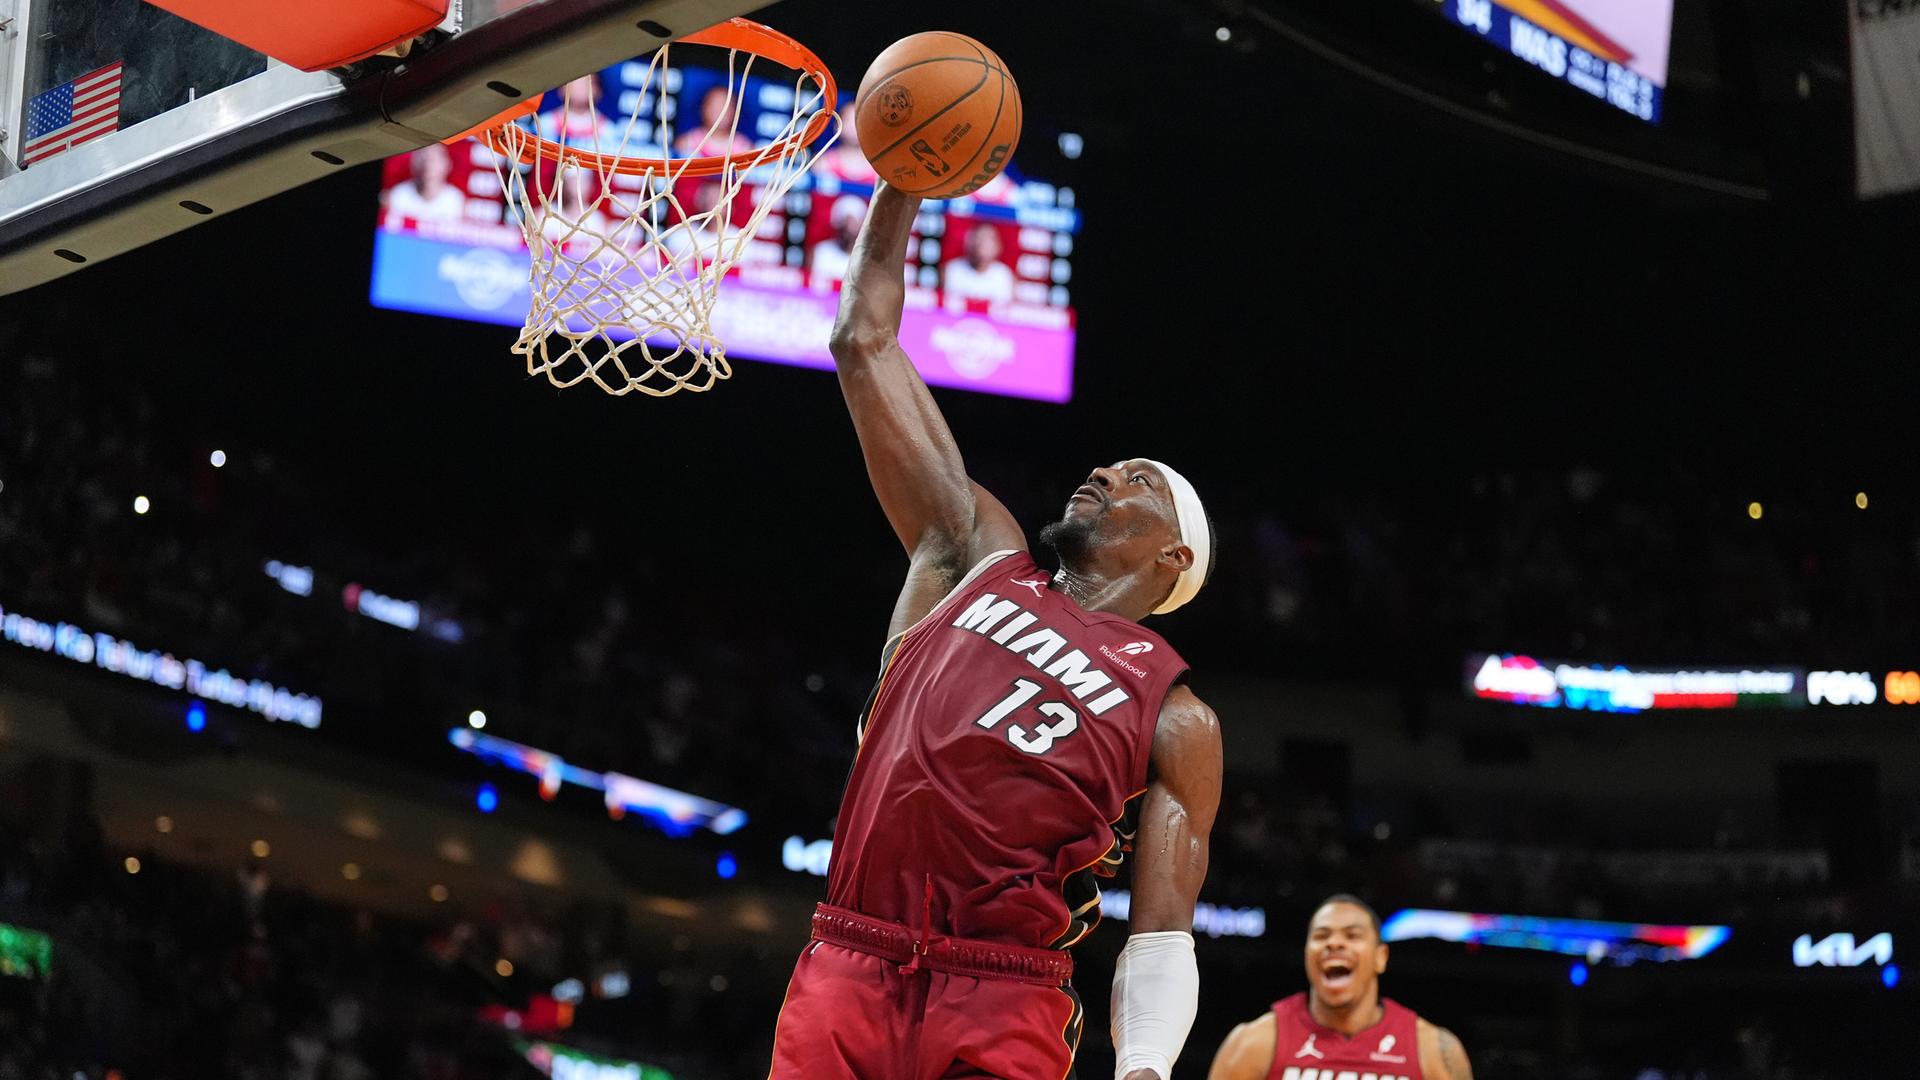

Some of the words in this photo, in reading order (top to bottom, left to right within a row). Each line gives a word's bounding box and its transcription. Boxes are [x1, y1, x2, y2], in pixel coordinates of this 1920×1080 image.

[952, 592, 1130, 716] MIAMI
[1098, 644, 1147, 679] Robinhood
[974, 676, 1080, 755] 13
